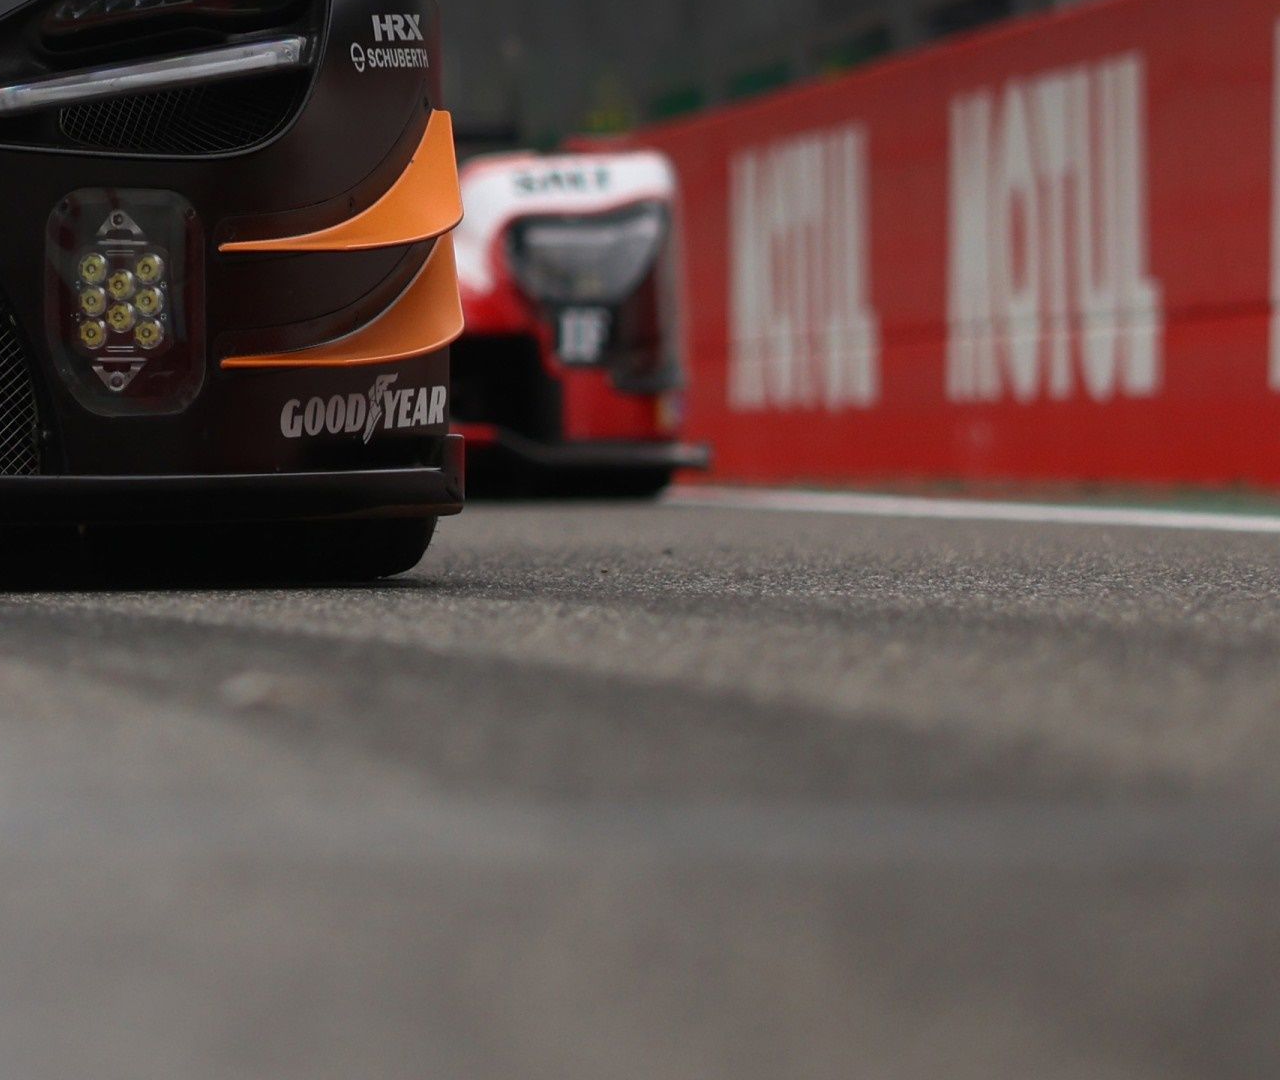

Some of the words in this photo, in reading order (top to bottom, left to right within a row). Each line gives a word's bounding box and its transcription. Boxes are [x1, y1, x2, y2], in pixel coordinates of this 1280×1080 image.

[371, 13, 424, 42] HRX
[366, 47, 430, 69] SCHUBERTH
[279, 382, 448, 440] GOODYEAR
